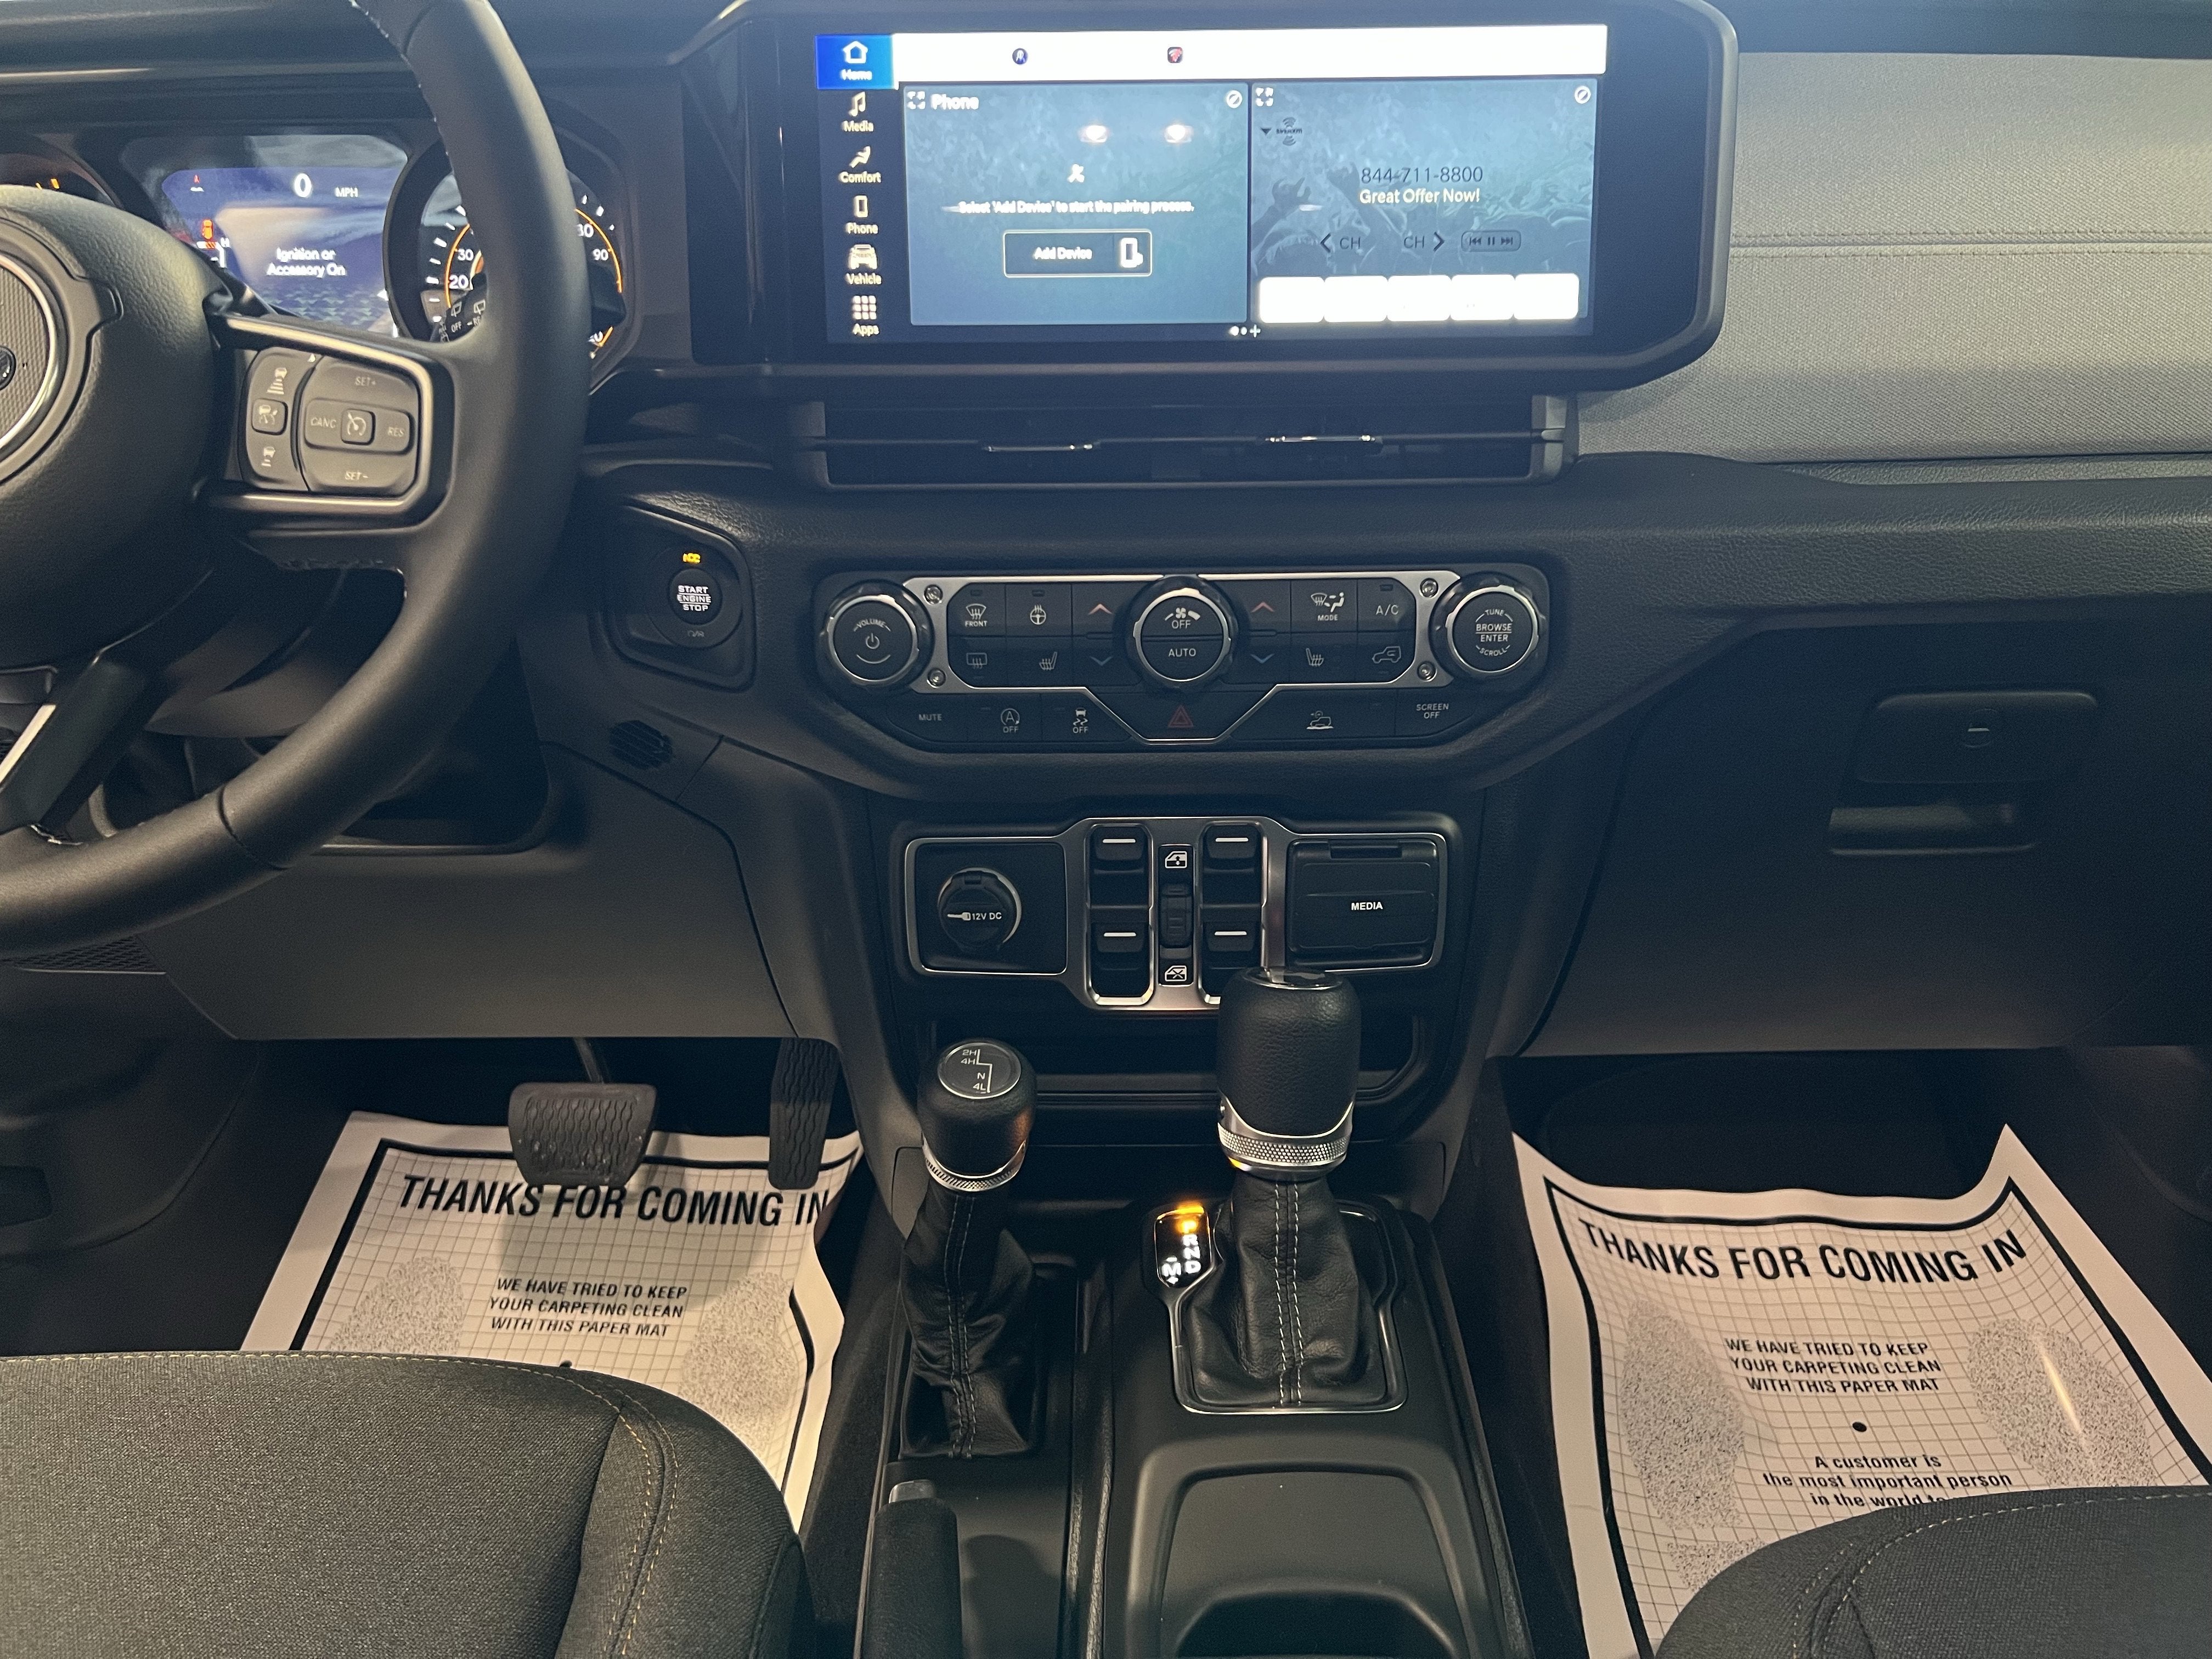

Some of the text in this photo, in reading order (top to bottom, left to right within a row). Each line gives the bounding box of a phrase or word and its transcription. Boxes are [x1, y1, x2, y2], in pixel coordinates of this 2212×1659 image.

[931, 94, 979, 110] Phone
[842, 121, 874, 132] Media
[839, 171, 882, 183] Comfort
[1361, 166, 1482, 184] 844-711-8800
[294, 173, 358, 198] 0 MPH
[1359, 188, 1480, 204] Great Offer Now!
[1056, 201, 1068, 213] to
[1069, 201, 1093, 213] start
[1094, 200, 1113, 212] the
[1113, 199, 1150, 214] pairing
[846, 222, 878, 234] Phone
[1340, 236, 1361, 250] CH
[1403, 236, 1425, 249] CH
[276, 247, 336, 263] Ignition or
[458, 249, 474, 261] 30
[592, 249, 609, 261] 90
[1034, 247, 1093, 259] Add Device
[266, 262, 347, 278] Accessory On
[449, 274, 469, 289] 20
[846, 273, 882, 284] Vehicle
[853, 324, 879, 336] Apps
[311, 417, 336, 428] CANC
[387, 426, 405, 437] RES
[678, 585, 709, 594] START
[676, 594, 712, 603] ENGINE
[682, 603, 708, 612] STOP
[1375, 604, 1399, 616] A/C
[1485, 608, 1504, 617] TUNE
[856, 618, 886, 628] VOLUME
[1171, 619, 1191, 629] OFF
[1476, 623, 1513, 631] BROWSE
[1480, 634, 1509, 642] ENTER
[1168, 648, 1197, 658] AUTO
[1479, 647, 1508, 657] SCROLL
[1416, 703, 1449, 712] SCREEN
[1424, 712, 1440, 720] OFF
[1002, 726, 1019, 734] OFF
[1073, 726, 1089, 734] OFF
[1351, 901, 1383, 911] MEDIA
[972, 912, 1002, 921] 12V DC
[400, 1174, 544, 1217] THANKS
[552, 1184, 627, 1219] FOR
[637, 1186, 783, 1226] COMING
[1182, 1234, 1199, 1246] R
[1184, 1246, 1201, 1260] N
[1578, 1217, 2027, 1283] THANKS FOR COMING IN
[1185, 1260, 1201, 1274] D
[497, 1278, 687, 1300] WE HAVE TRIED TO KEEP
[489, 1296, 684, 1318] YOUR CARPETING CLEAN
[491, 1317, 670, 1337] WITH THIS PAPER MAT
[1725, 1338, 1928, 1357] WE HAVE TRIED TO KEEP
[1730, 1356, 1942, 1374] YOUR CARPETING CLEAN
[1746, 1377, 1940, 1393] WITH THIS PAPER MAT
[1815, 1454, 1942, 1469] A customer is
[1763, 1472, 2013, 1492] the most important person
[1810, 1493, 1825, 1505] in
[1833, 1493, 1865, 1506] the
